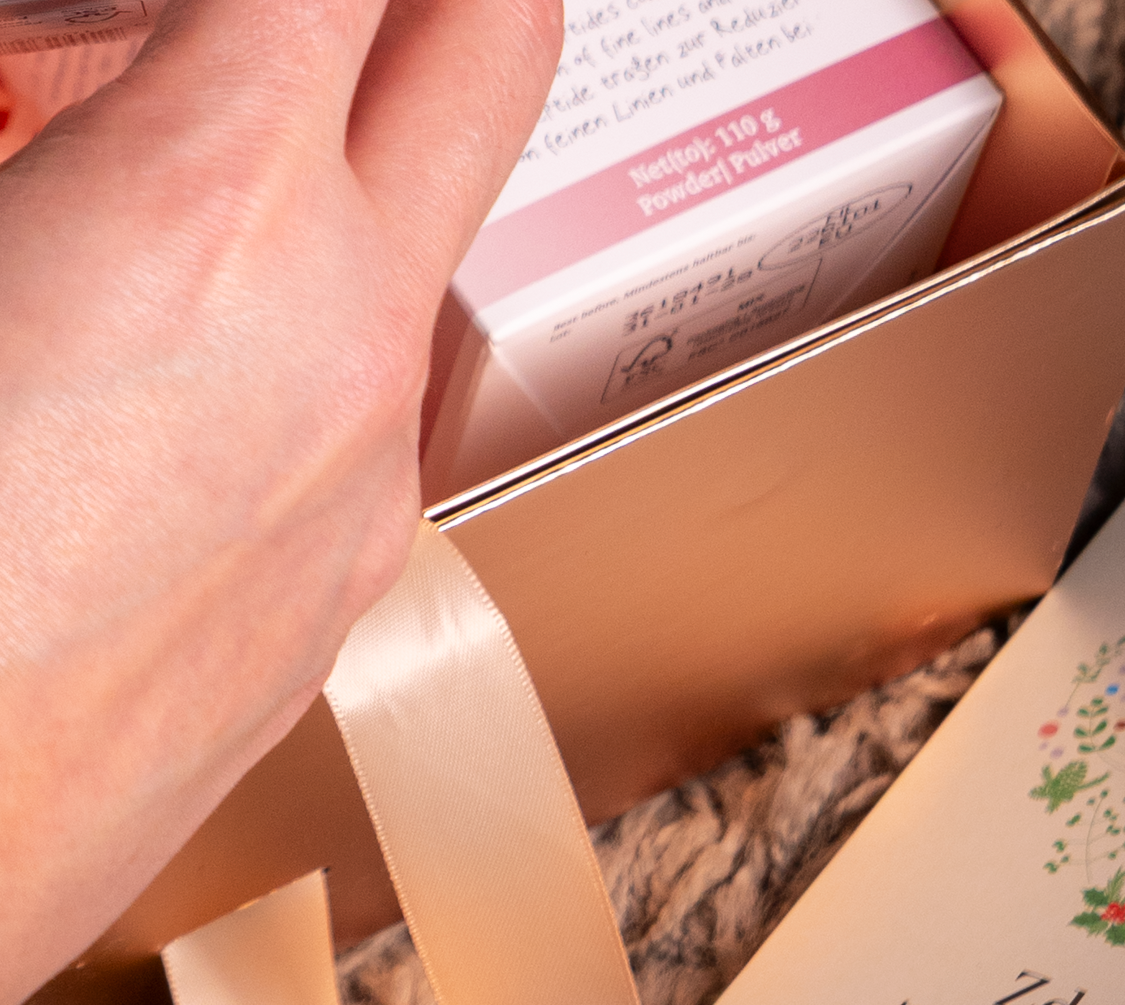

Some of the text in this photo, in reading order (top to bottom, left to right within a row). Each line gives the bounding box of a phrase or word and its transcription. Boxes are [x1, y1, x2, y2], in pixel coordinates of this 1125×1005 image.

[600, 26, 641, 59] fine
[641, 2, 692, 37] lines
[627, 104, 783, 189] Net(to): 110 g
[730, 125, 804, 175] Pulver
